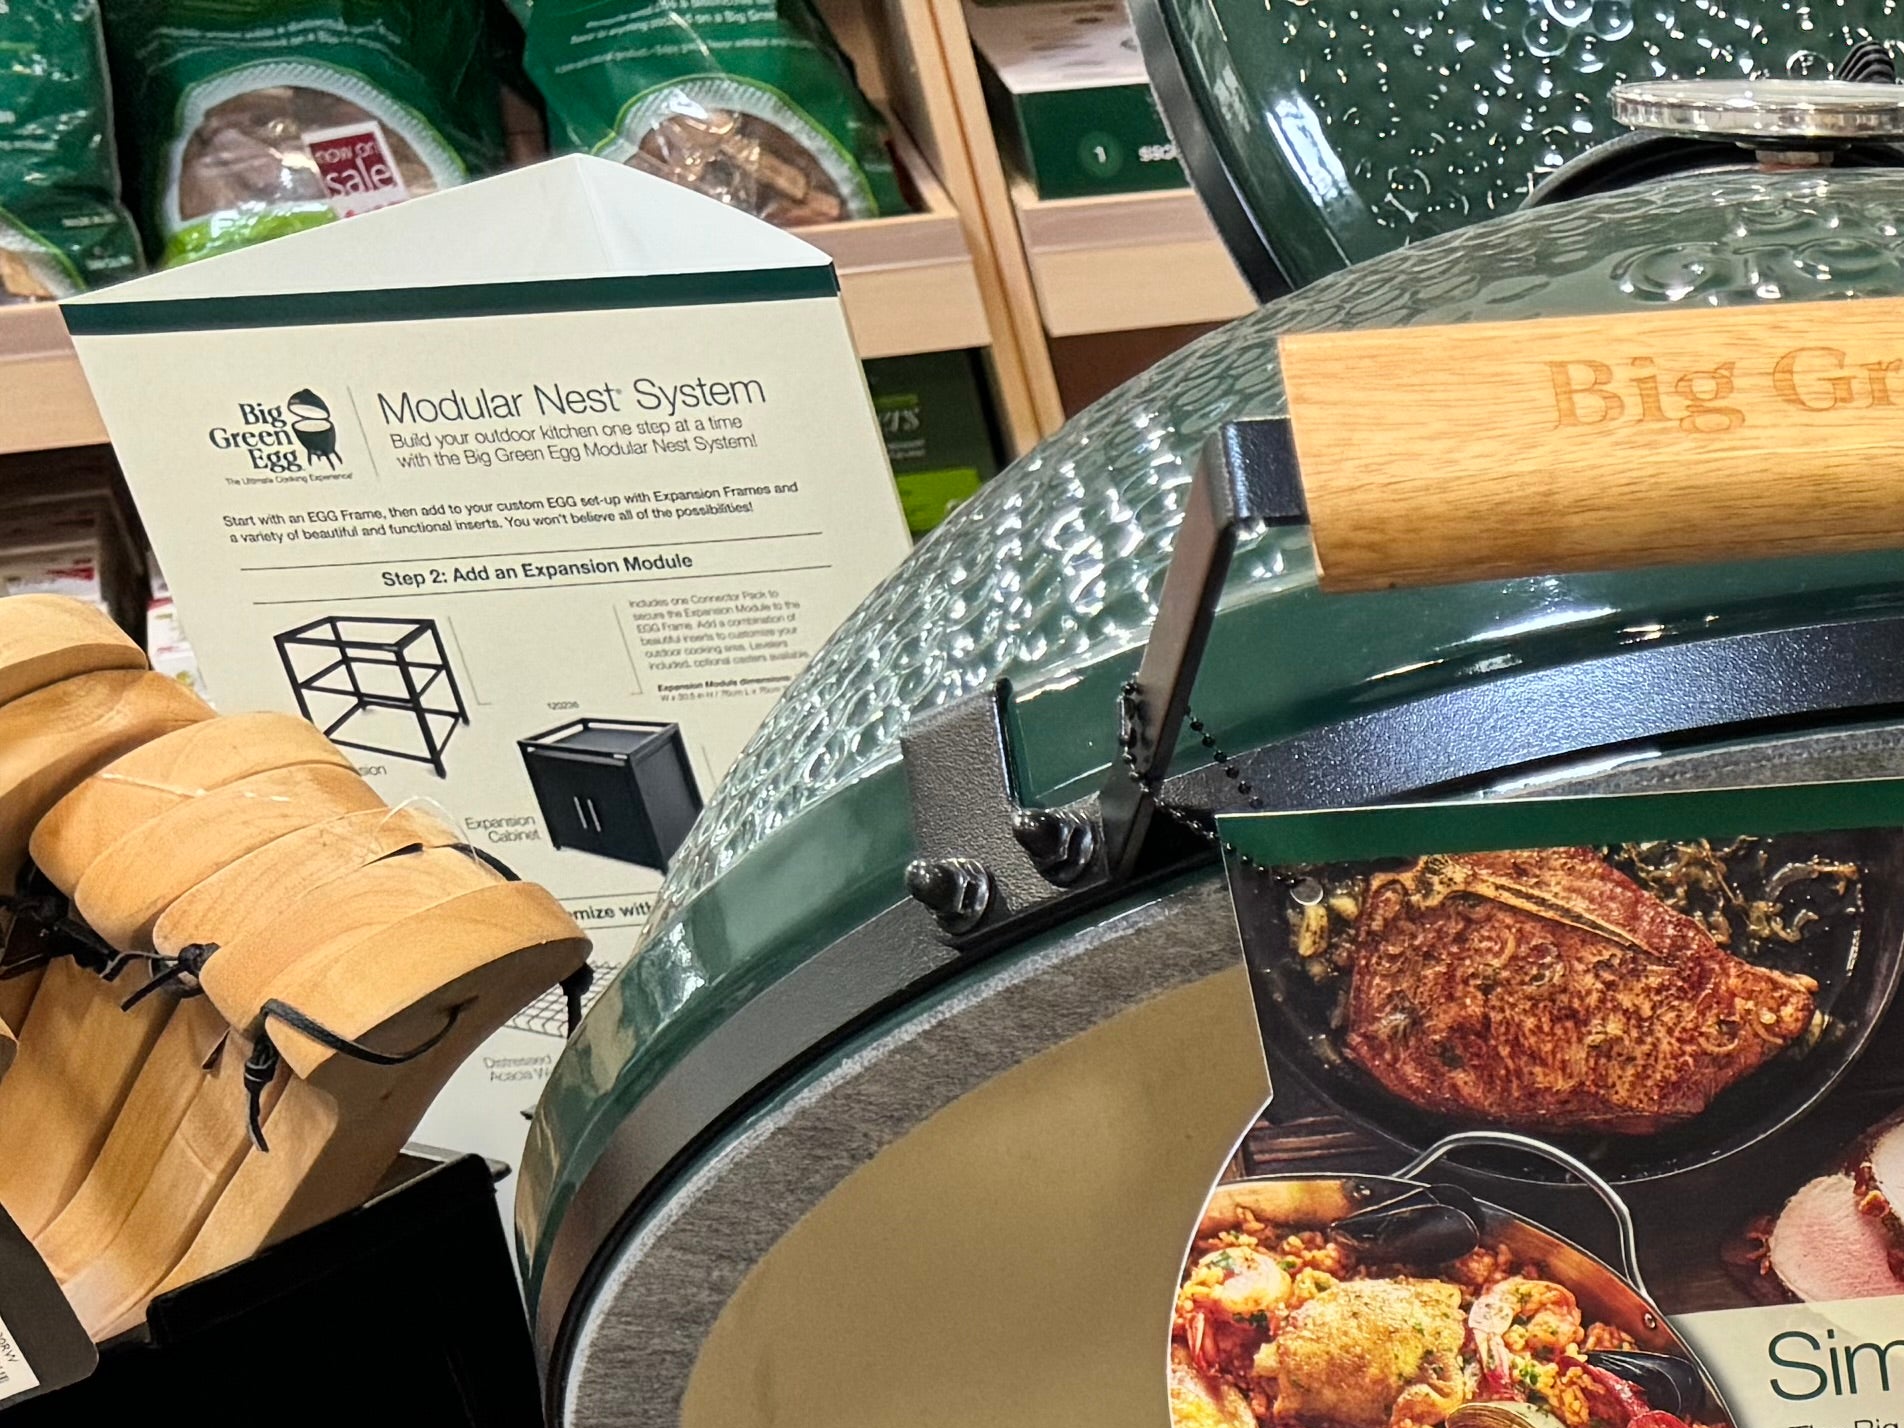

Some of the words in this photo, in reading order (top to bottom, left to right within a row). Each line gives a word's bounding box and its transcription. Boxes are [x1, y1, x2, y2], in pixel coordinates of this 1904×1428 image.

[326, 157, 392, 198] sale
[377, 388, 523, 424] Modular
[633, 376, 767, 417] System
[1547, 356, 1747, 434] Big
[238, 402, 288, 429] Big
[390, 433, 432, 450] Build
[434, 433, 469, 449] your
[474, 427, 537, 445] outdoor
[540, 423, 598, 442] kitchen
[602, 422, 633, 437] one
[637, 419, 671, 437] step
[675, 418, 691, 432] at
[694, 418, 706, 432] a
[708, 414, 744, 430] time
[208, 427, 293, 450] Green
[396, 452, 431, 470] with
[435, 448, 462, 467] the
[464, 449, 493, 469] Big
[495, 445, 545, 464] Green
[549, 443, 582, 464] Egg
[584, 439, 649, 459] Modular
[653, 437, 691, 454] Nest
[694, 433, 759, 453] System!
[248, 448, 303, 474] Egg
[381, 569, 426, 588] Step
[429, 568, 448, 584] 2:
[452, 565, 491, 583] Add
[495, 566, 518, 581] an
[523, 556, 620, 580] Expansion
[623, 553, 693, 572] Module
[464, 816, 536, 831] Expansion
[488, 829, 542, 844] Cabinet
